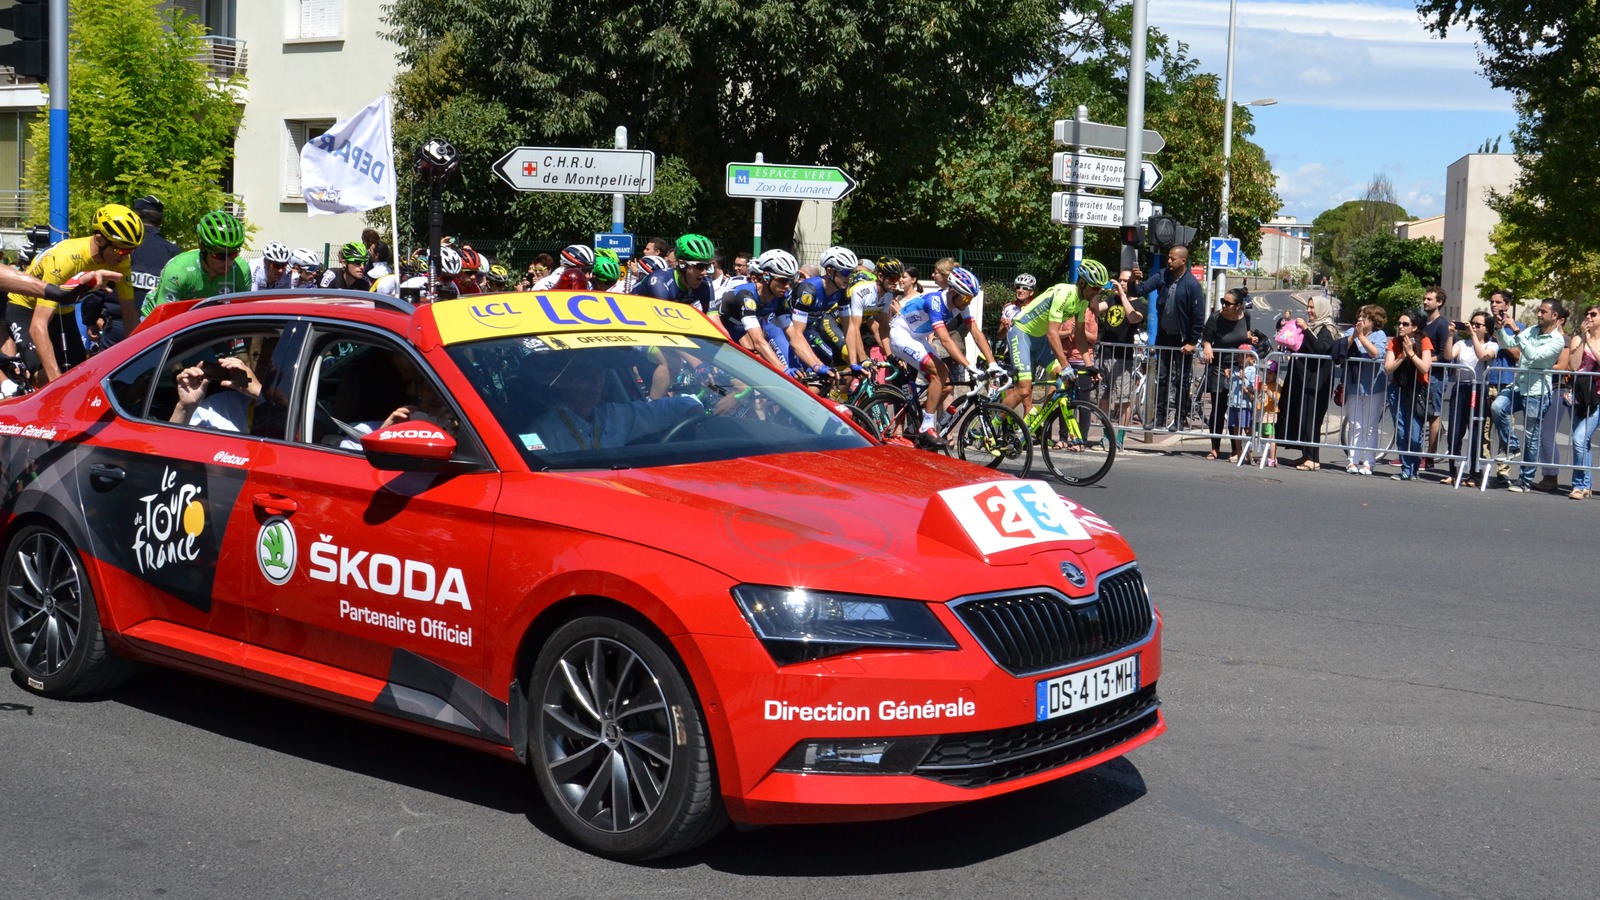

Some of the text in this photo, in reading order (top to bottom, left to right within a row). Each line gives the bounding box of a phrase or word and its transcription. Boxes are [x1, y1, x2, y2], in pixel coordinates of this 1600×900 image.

[543, 156, 597, 169] C.H.R.U.
[1075, 159, 1125, 174] Parc Agropo
[543, 172, 647, 189] de Montpellier
[755, 168, 833, 180] ESPACE VERT
[1072, 171, 1090, 180] Palais
[1103, 174, 1121, 184] Sports
[755, 182, 832, 195] Zoo de Lunaret
[1064, 198, 1103, 210] Universités
[1064, 208, 1085, 221] Église
[1086, 211, 1107, 222] Sainte
[130, 272, 161, 287] OLICE
[471, 302, 522, 318] LCL
[535, 295, 647, 326] LCL
[653, 305, 691, 321] LCL
[823, 319, 839, 343] JUMBO
[576, 335, 679, 345] OFFICIEL 1
[1011, 335, 1025, 371] Tinkoff
[0, 421, 23, 435] irection
[379, 429, 445, 440] ŠKODA
[213, 451, 249, 466] @letour
[134, 512, 143, 525] de
[309, 533, 472, 611] ŠKODA
[340, 599, 472, 647] Partenaire Officiel
[764, 697, 976, 721] Direction Générale
